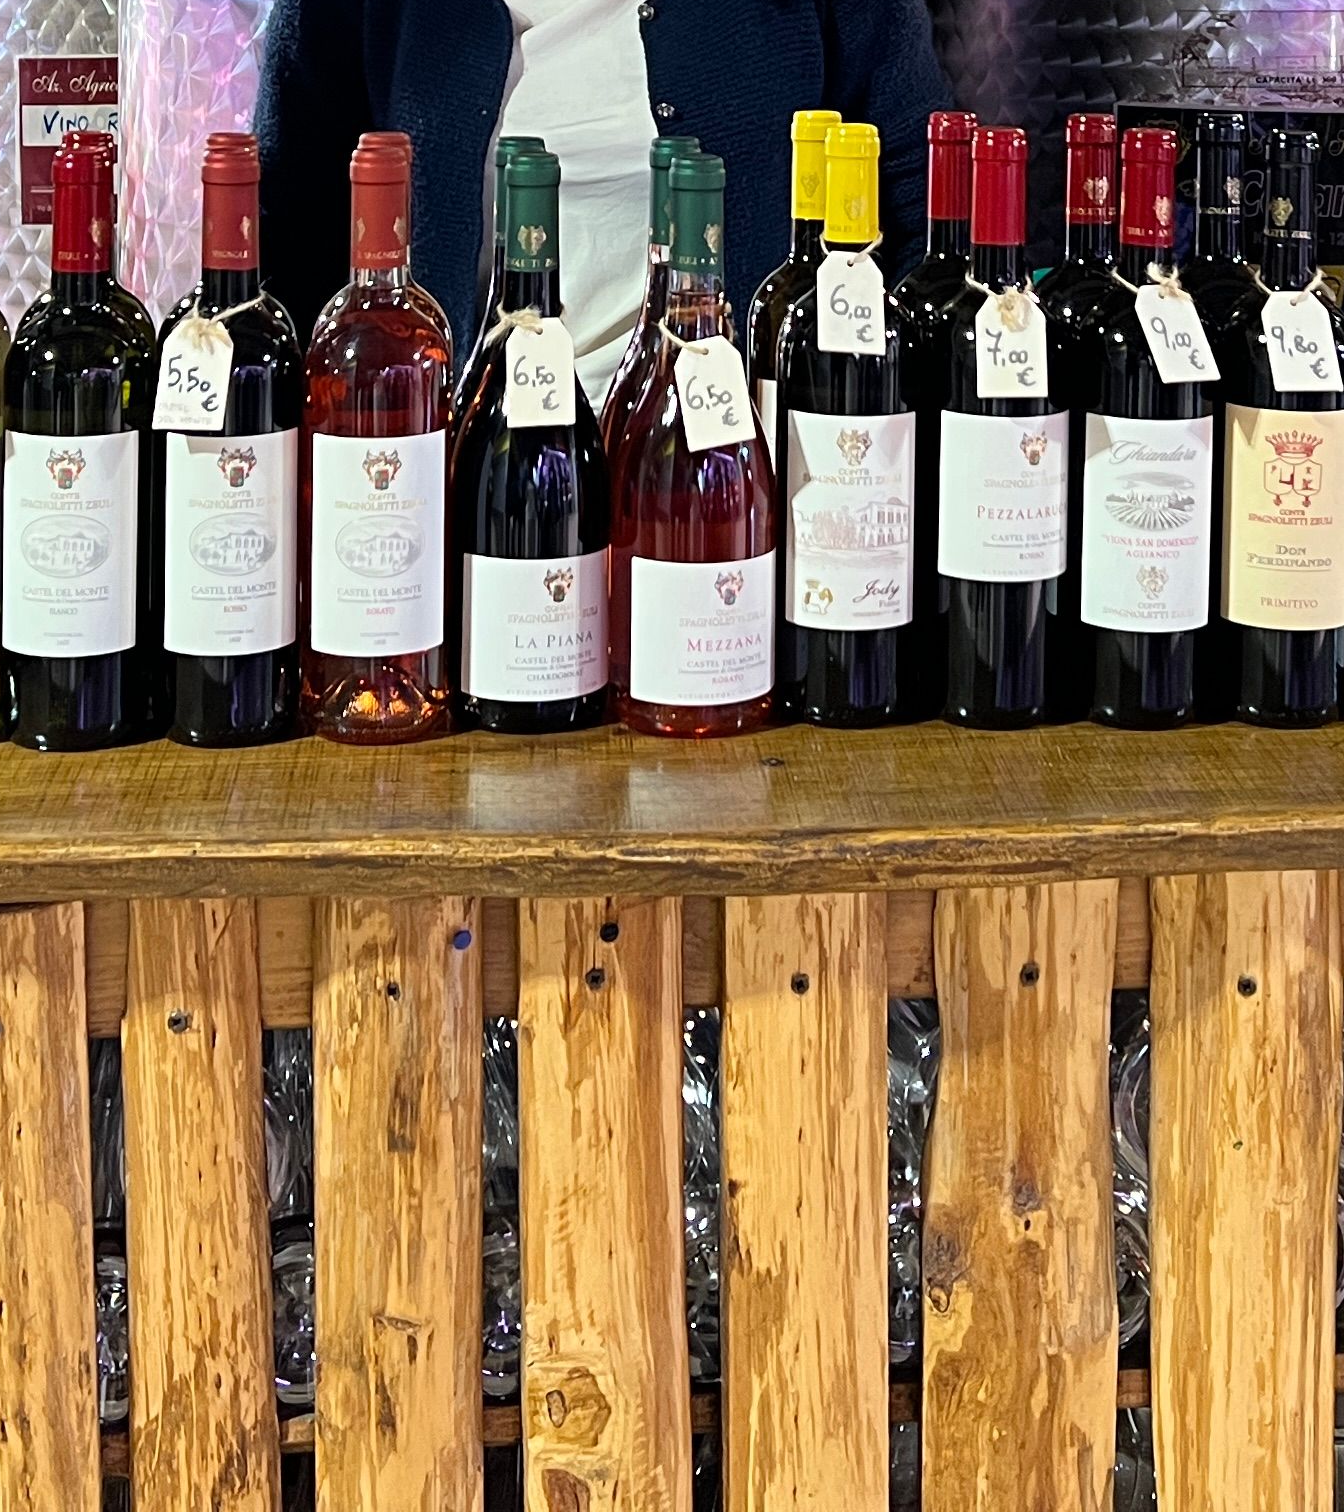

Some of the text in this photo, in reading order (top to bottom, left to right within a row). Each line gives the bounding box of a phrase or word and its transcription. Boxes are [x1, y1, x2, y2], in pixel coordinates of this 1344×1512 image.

[43, 110, 89, 134] VINO
[830, 284, 872, 320] 6,00
[856, 324, 874, 343] €
[1150, 317, 1191, 351] 9,00
[1271, 326, 1318, 357] 9,80
[986, 328, 1028, 366] 7,00
[1189, 349, 1206, 370] €
[1310, 357, 1329, 379] €
[167, 355, 211, 393] 5,50
[513, 355, 556, 388] 6,50
[1017, 367, 1036, 386] €
[201, 392, 219, 412] €
[542, 390, 560, 410] €
[686, 375, 732, 410] 6,50
[721, 406, 740, 428] €
[1136, 537, 1154, 547] SAN
[1276, 544, 1306, 557] DON
[1126, 549, 1181, 560] AGLIANICO
[74, 586, 109, 597] MONTE
[191, 585, 226, 595] CASTEL
[853, 579, 900, 603] Jody
[1260, 596, 1318, 609] PRIMITIVO
[515, 630, 593, 649] LA PIANA
[687, 633, 762, 652] MEZZANA
